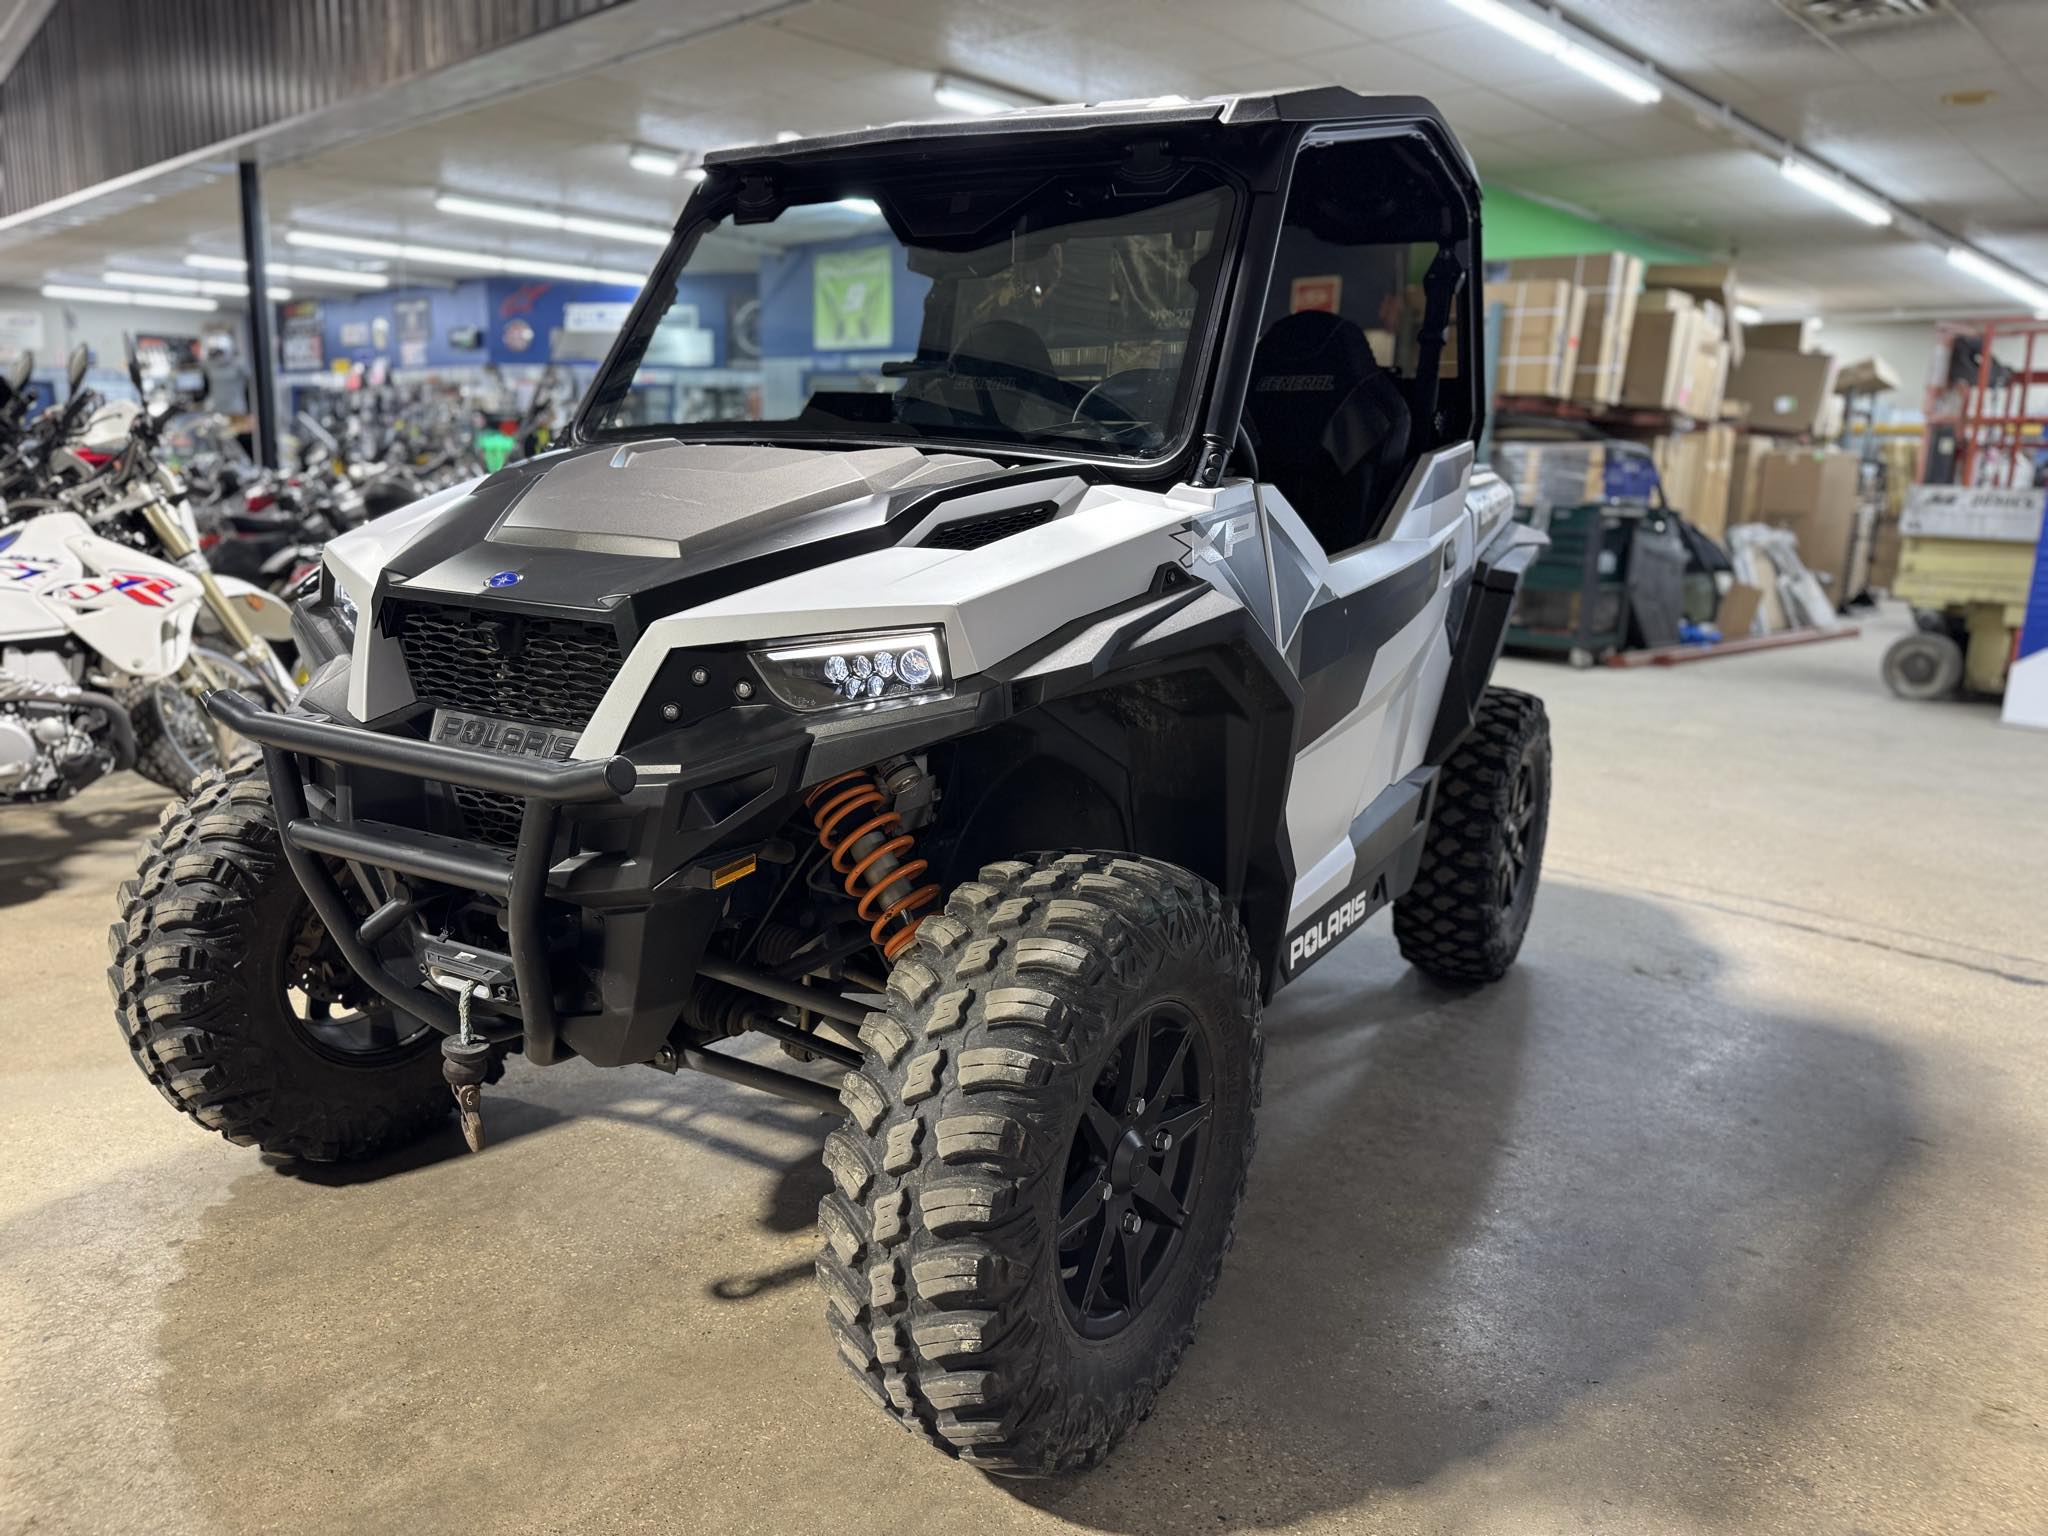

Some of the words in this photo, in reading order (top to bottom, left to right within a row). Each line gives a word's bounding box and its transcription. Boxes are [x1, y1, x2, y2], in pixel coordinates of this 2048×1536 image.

[1256, 374, 1337, 392] GENERAL
[1168, 510, 1256, 568] XP
[436, 715, 579, 758] POLARIS
[1289, 889, 1367, 971] POLARIS
